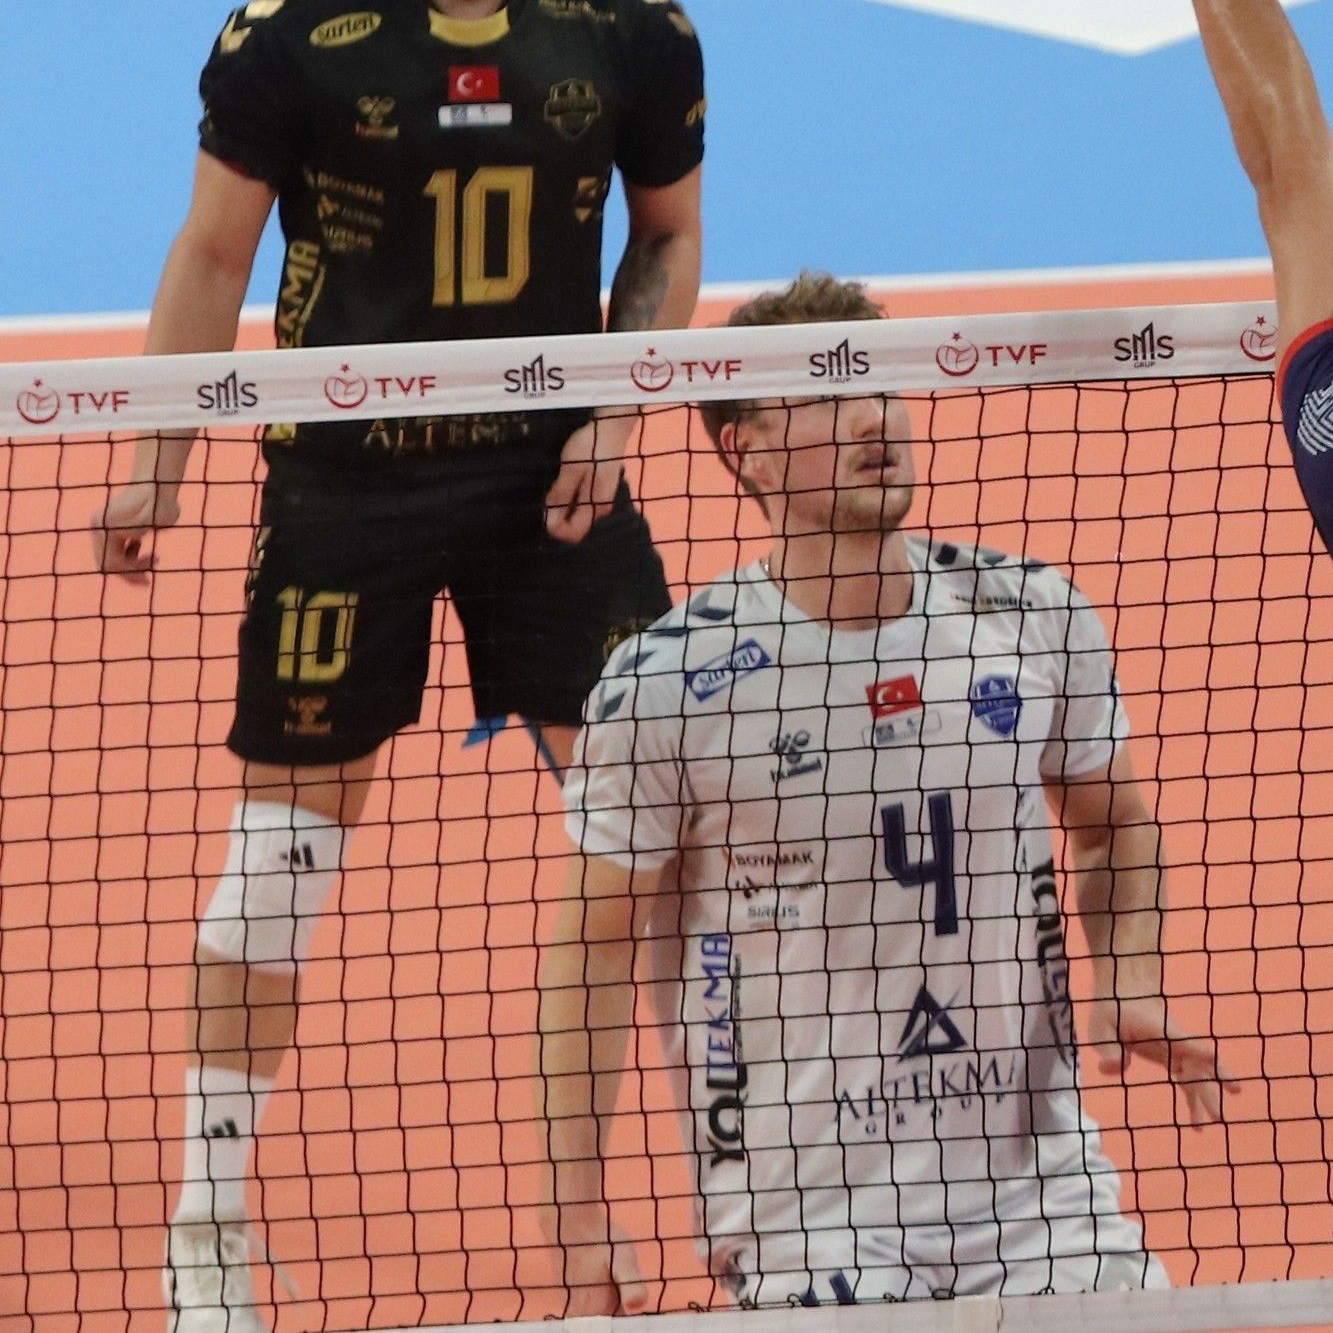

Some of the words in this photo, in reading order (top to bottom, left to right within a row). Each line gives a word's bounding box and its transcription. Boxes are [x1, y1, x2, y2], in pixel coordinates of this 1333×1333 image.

[423, 166, 534, 307] 10
[809, 338, 870, 378] SMS
[985, 344, 1047, 367] TVF
[1114, 321, 1174, 361] SMS
[197, 370, 258, 410] SMS
[375, 376, 437, 399] TVF
[504, 354, 565, 393] SMS
[681, 359, 742, 382] TVF
[68, 391, 129, 414] TVF
[276, 585, 359, 682] 10
[881, 791, 958, 936] 4
